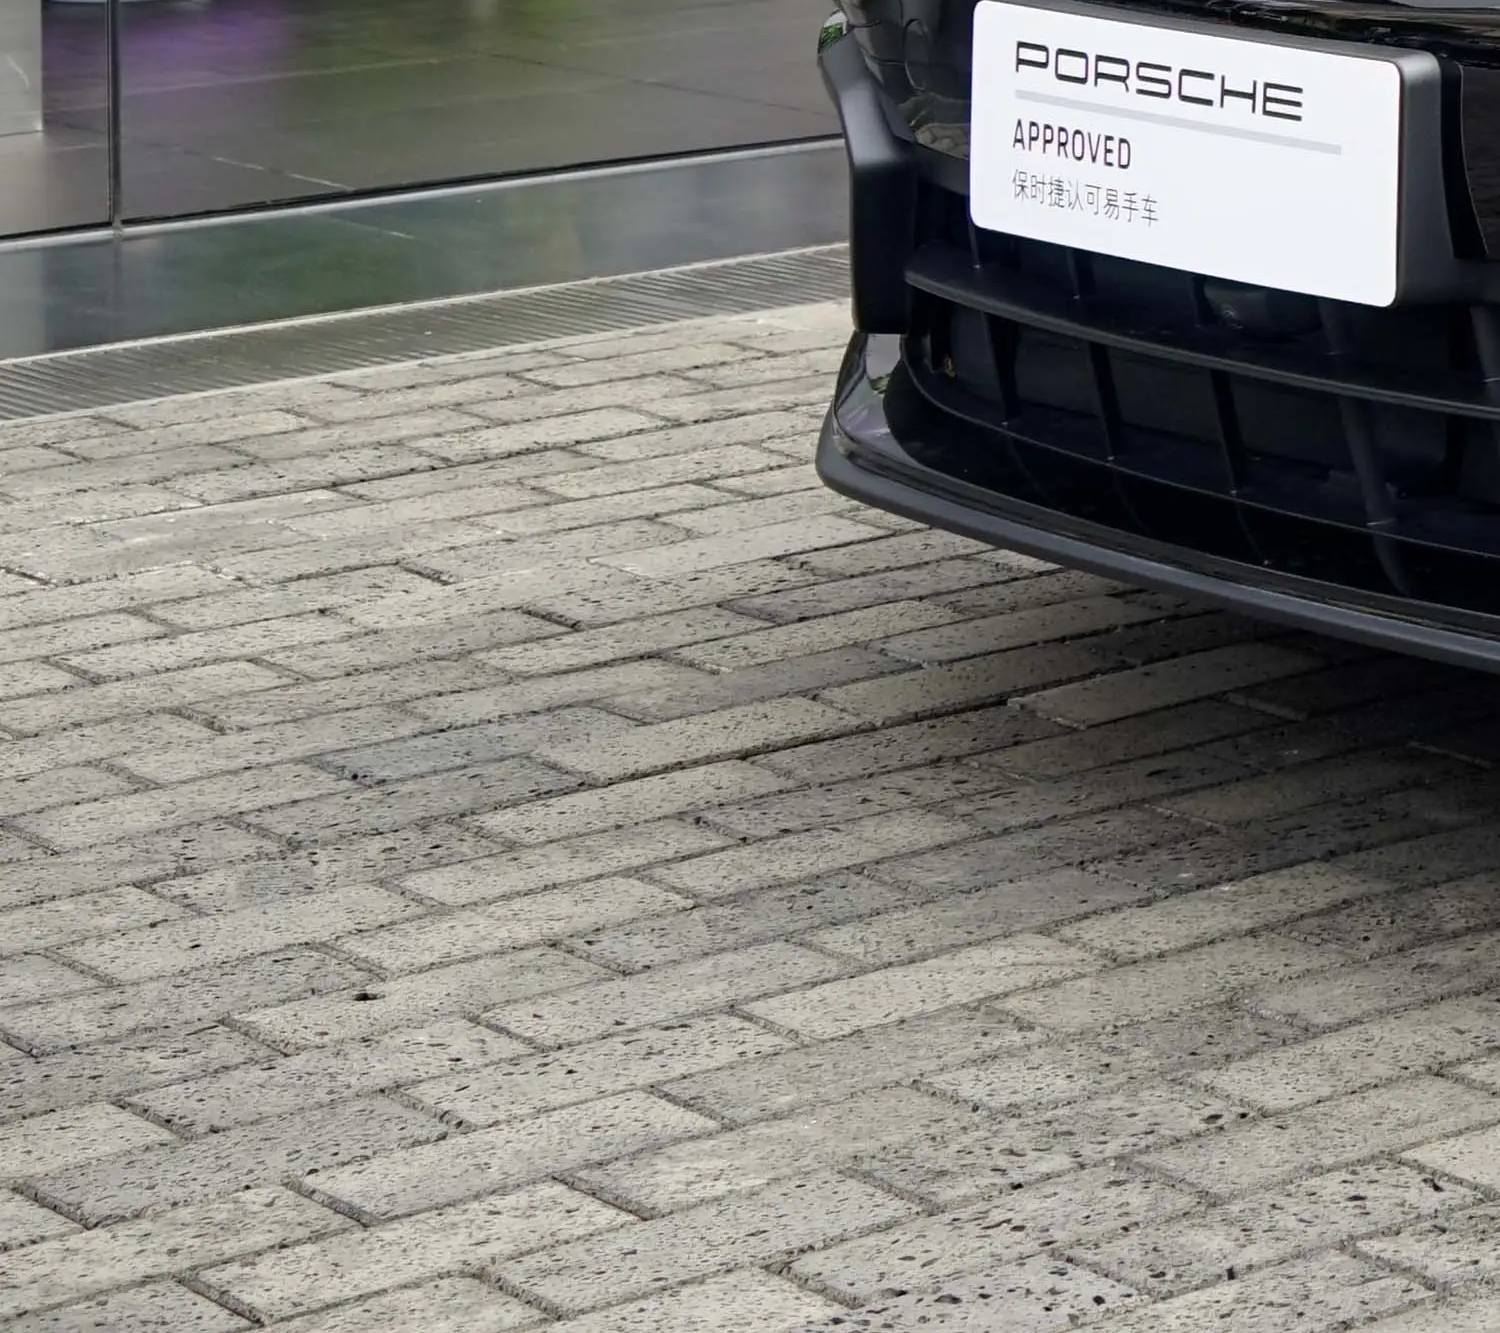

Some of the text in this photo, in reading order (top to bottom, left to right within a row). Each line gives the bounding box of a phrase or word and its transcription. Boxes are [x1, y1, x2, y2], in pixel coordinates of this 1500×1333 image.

[1014, 40, 1304, 123] PORSCHE
[1012, 118, 1132, 170] APPROVED
[1011, 169, 1160, 227] 保时捷认可易手车
